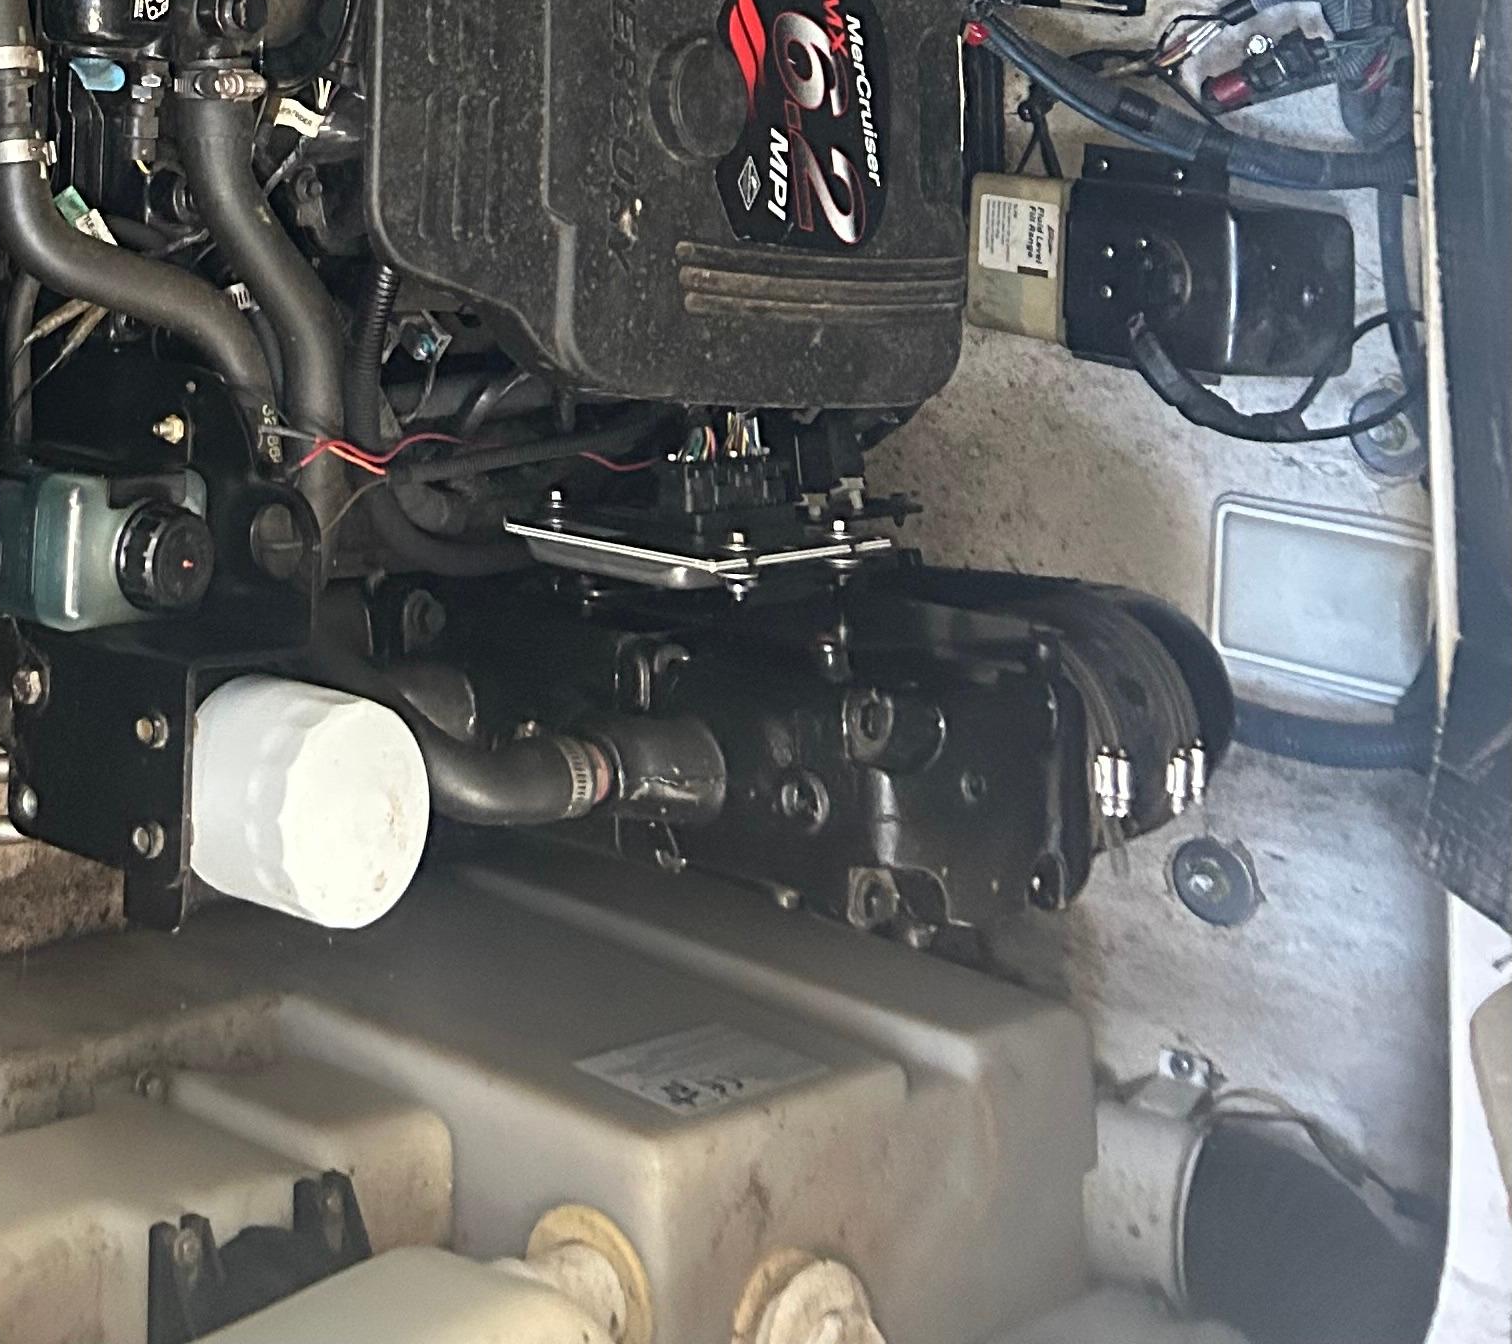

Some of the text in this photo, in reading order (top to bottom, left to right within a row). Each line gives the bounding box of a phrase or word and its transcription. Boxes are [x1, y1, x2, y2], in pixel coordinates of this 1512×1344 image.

[772, 11, 866, 245] 6.2
[845, 14, 881, 187] MerCruiser
[767, 127, 789, 221] MPI
[1026, 205, 1036, 258] Fill Range
[1034, 236, 1043, 264] Level
[1035, 207, 1044, 233] Fluid
